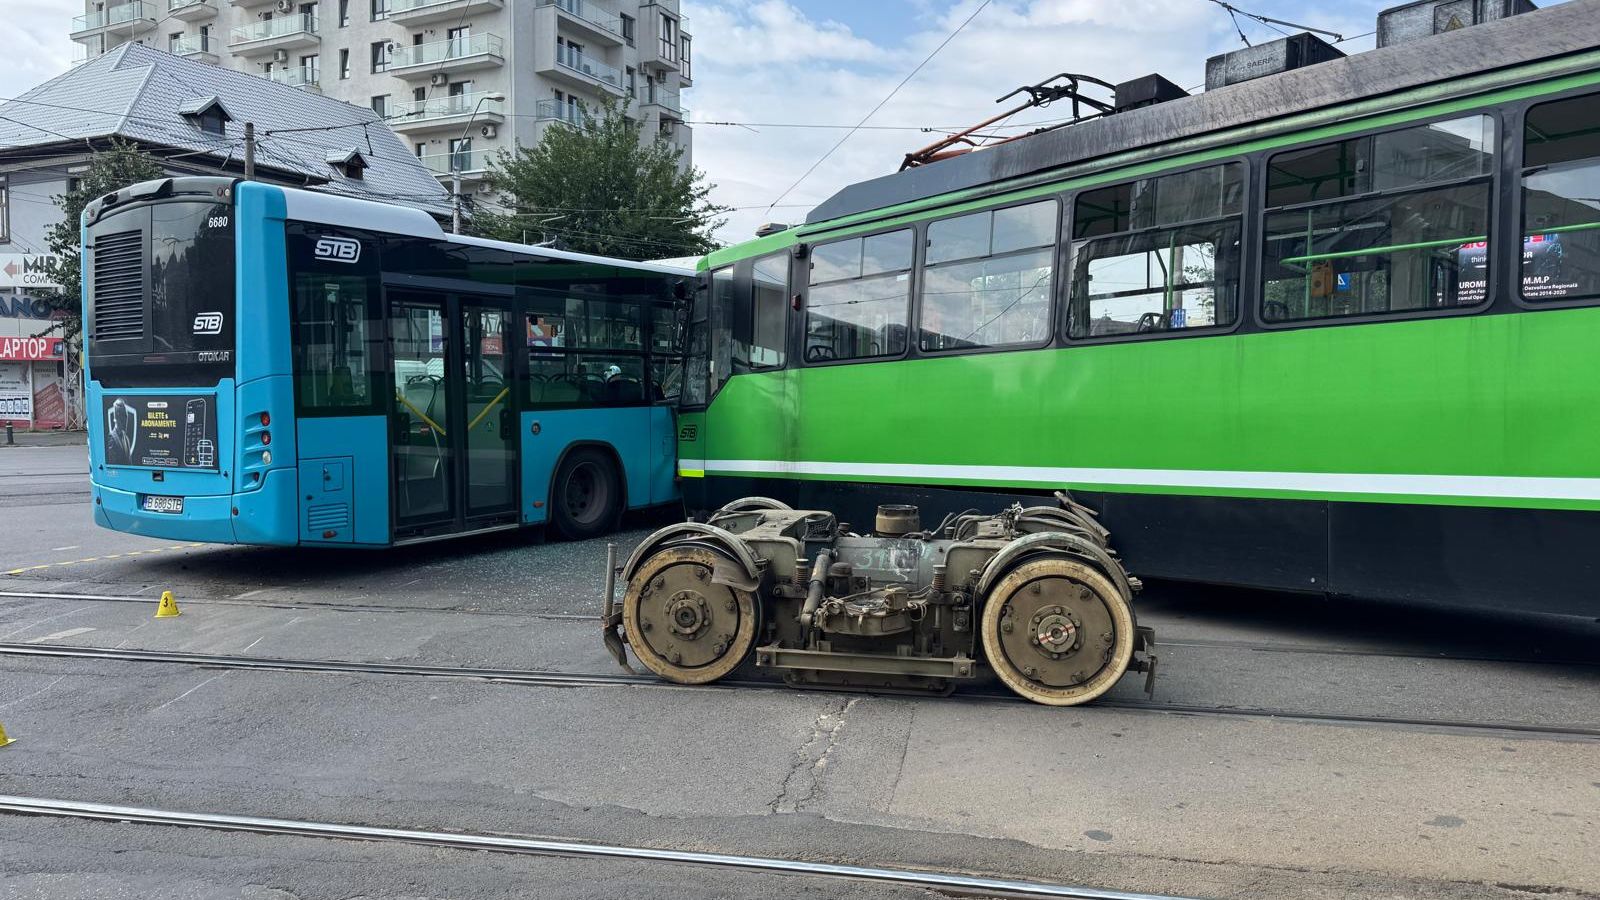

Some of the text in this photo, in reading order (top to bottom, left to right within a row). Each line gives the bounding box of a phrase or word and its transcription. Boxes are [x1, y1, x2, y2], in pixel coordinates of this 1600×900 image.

[208, 216, 228, 228] 6680
[315, 238, 359, 260] STB
[193, 314, 222, 332] STB
[198, 351, 230, 362] OTOKAR
[679, 426, 697, 440] STB
[163, 596, 169, 608] 3
